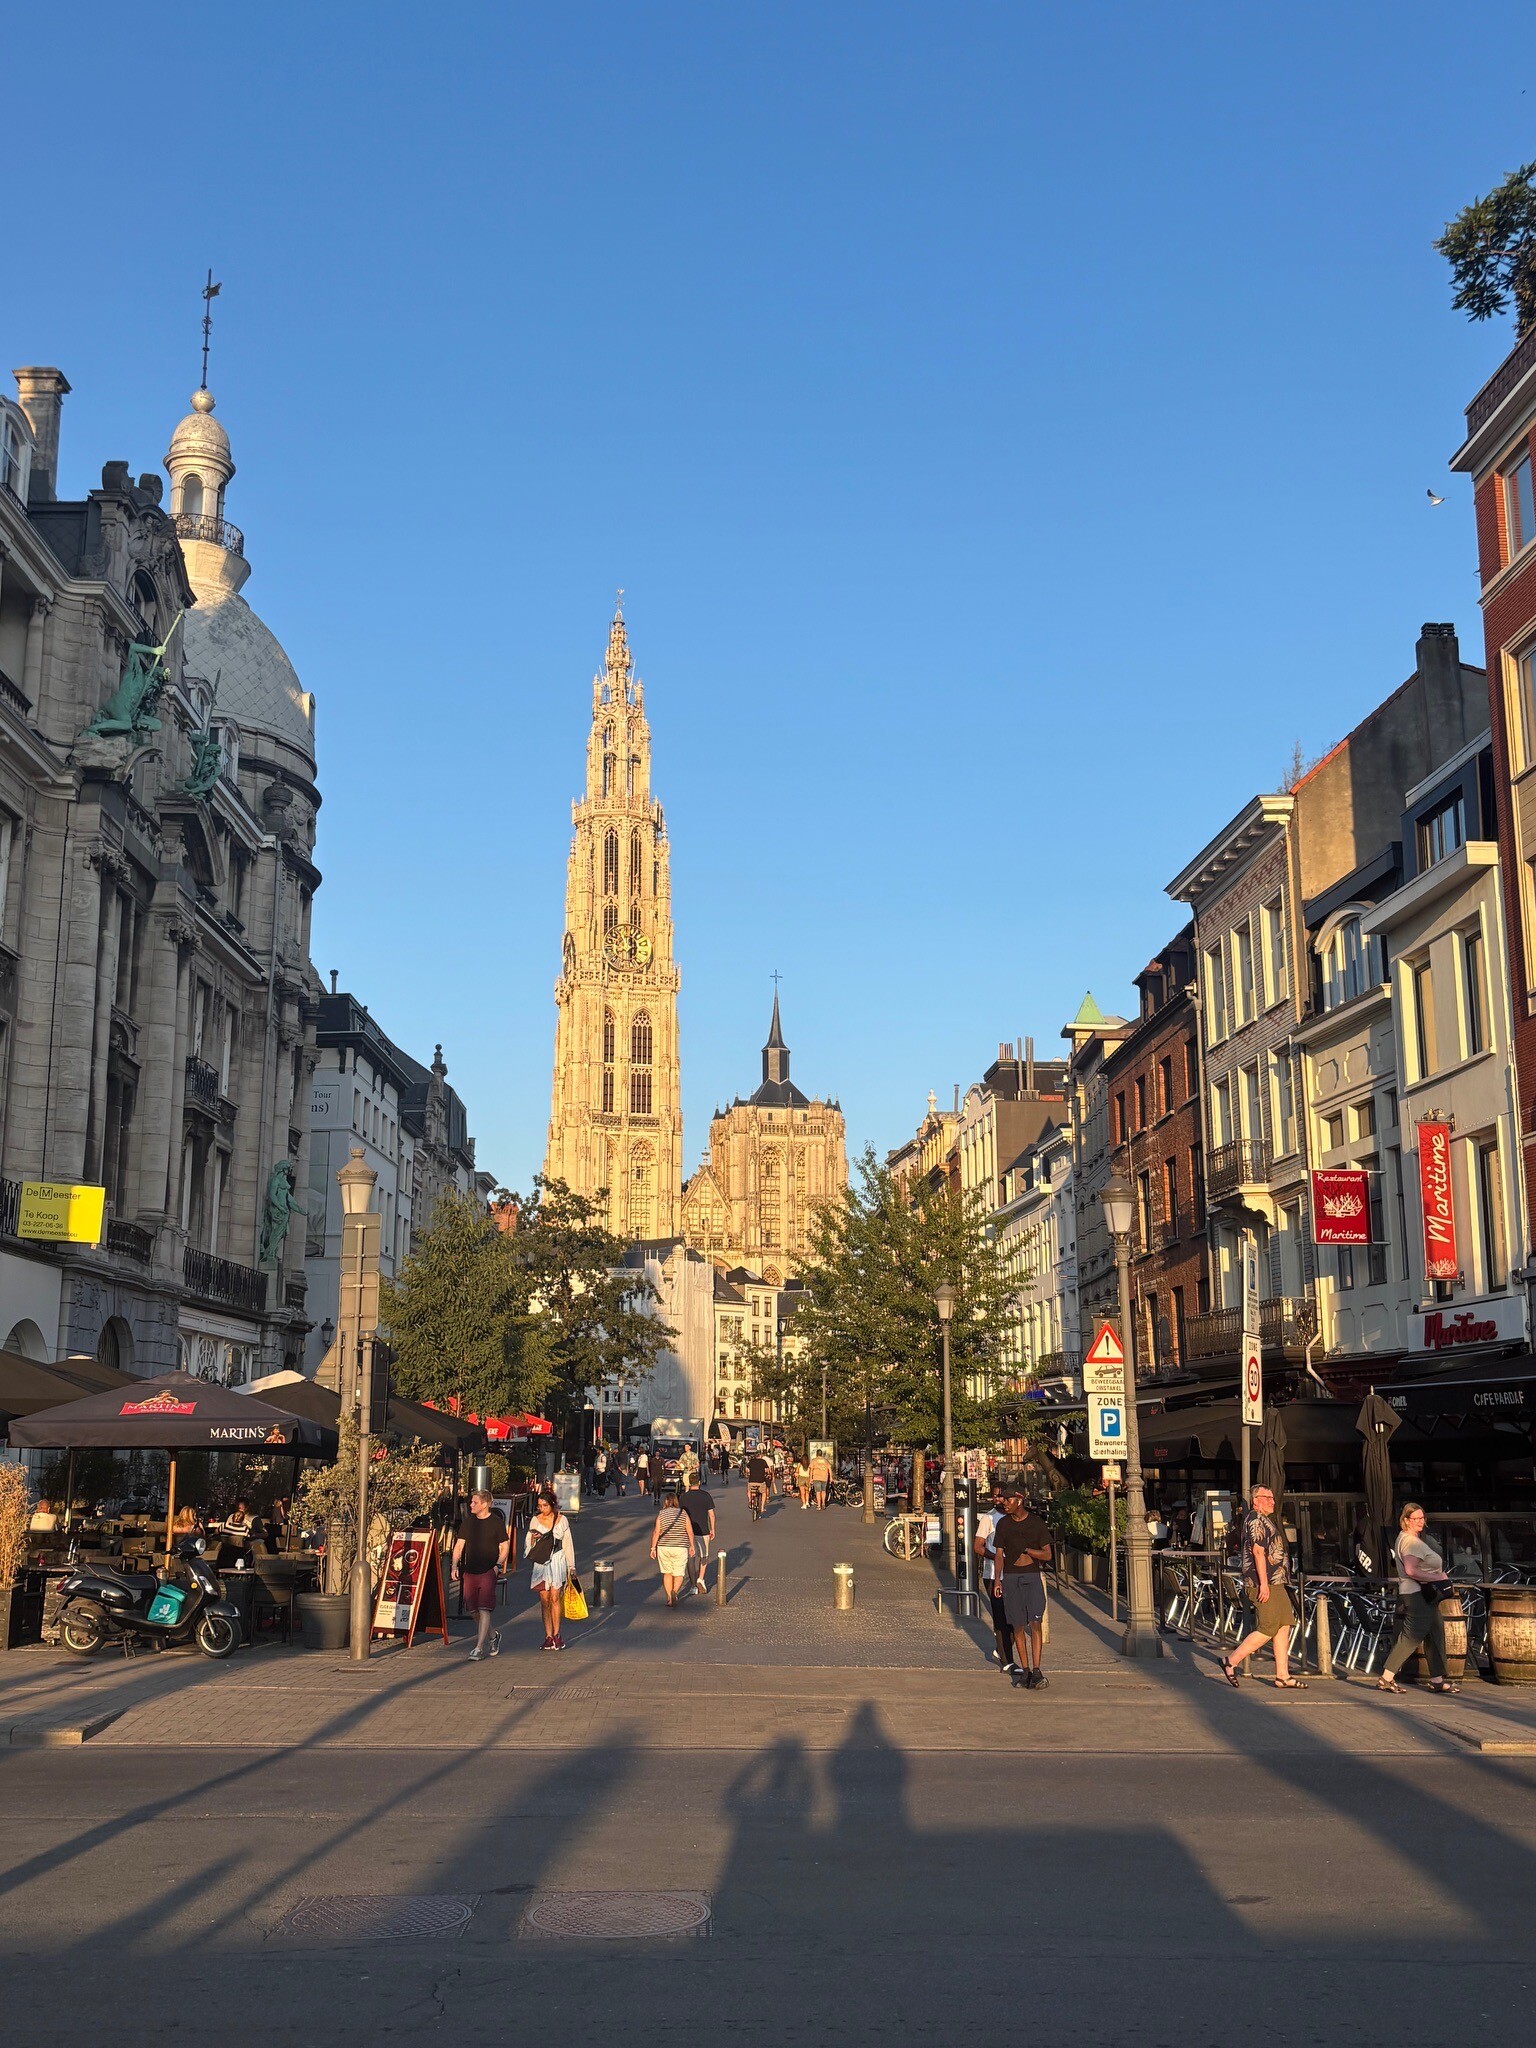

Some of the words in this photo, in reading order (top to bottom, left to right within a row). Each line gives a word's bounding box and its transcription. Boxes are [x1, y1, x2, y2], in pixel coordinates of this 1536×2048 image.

[313, 1090, 332, 1099] Tour
[1316, 1171, 1363, 1183] Restaurant
[1426, 1132, 1453, 1243] Maritime
[24, 1210, 34, 1218] Te
[36, 1211, 59, 1222] Koop
[1320, 1228, 1367, 1241] Maritime
[1251, 1370, 1257, 1386] 30
[1097, 1397, 1123, 1406] ZONE
[1103, 1412, 1117, 1433] P
[210, 1426, 266, 1440] MARTIN'S
